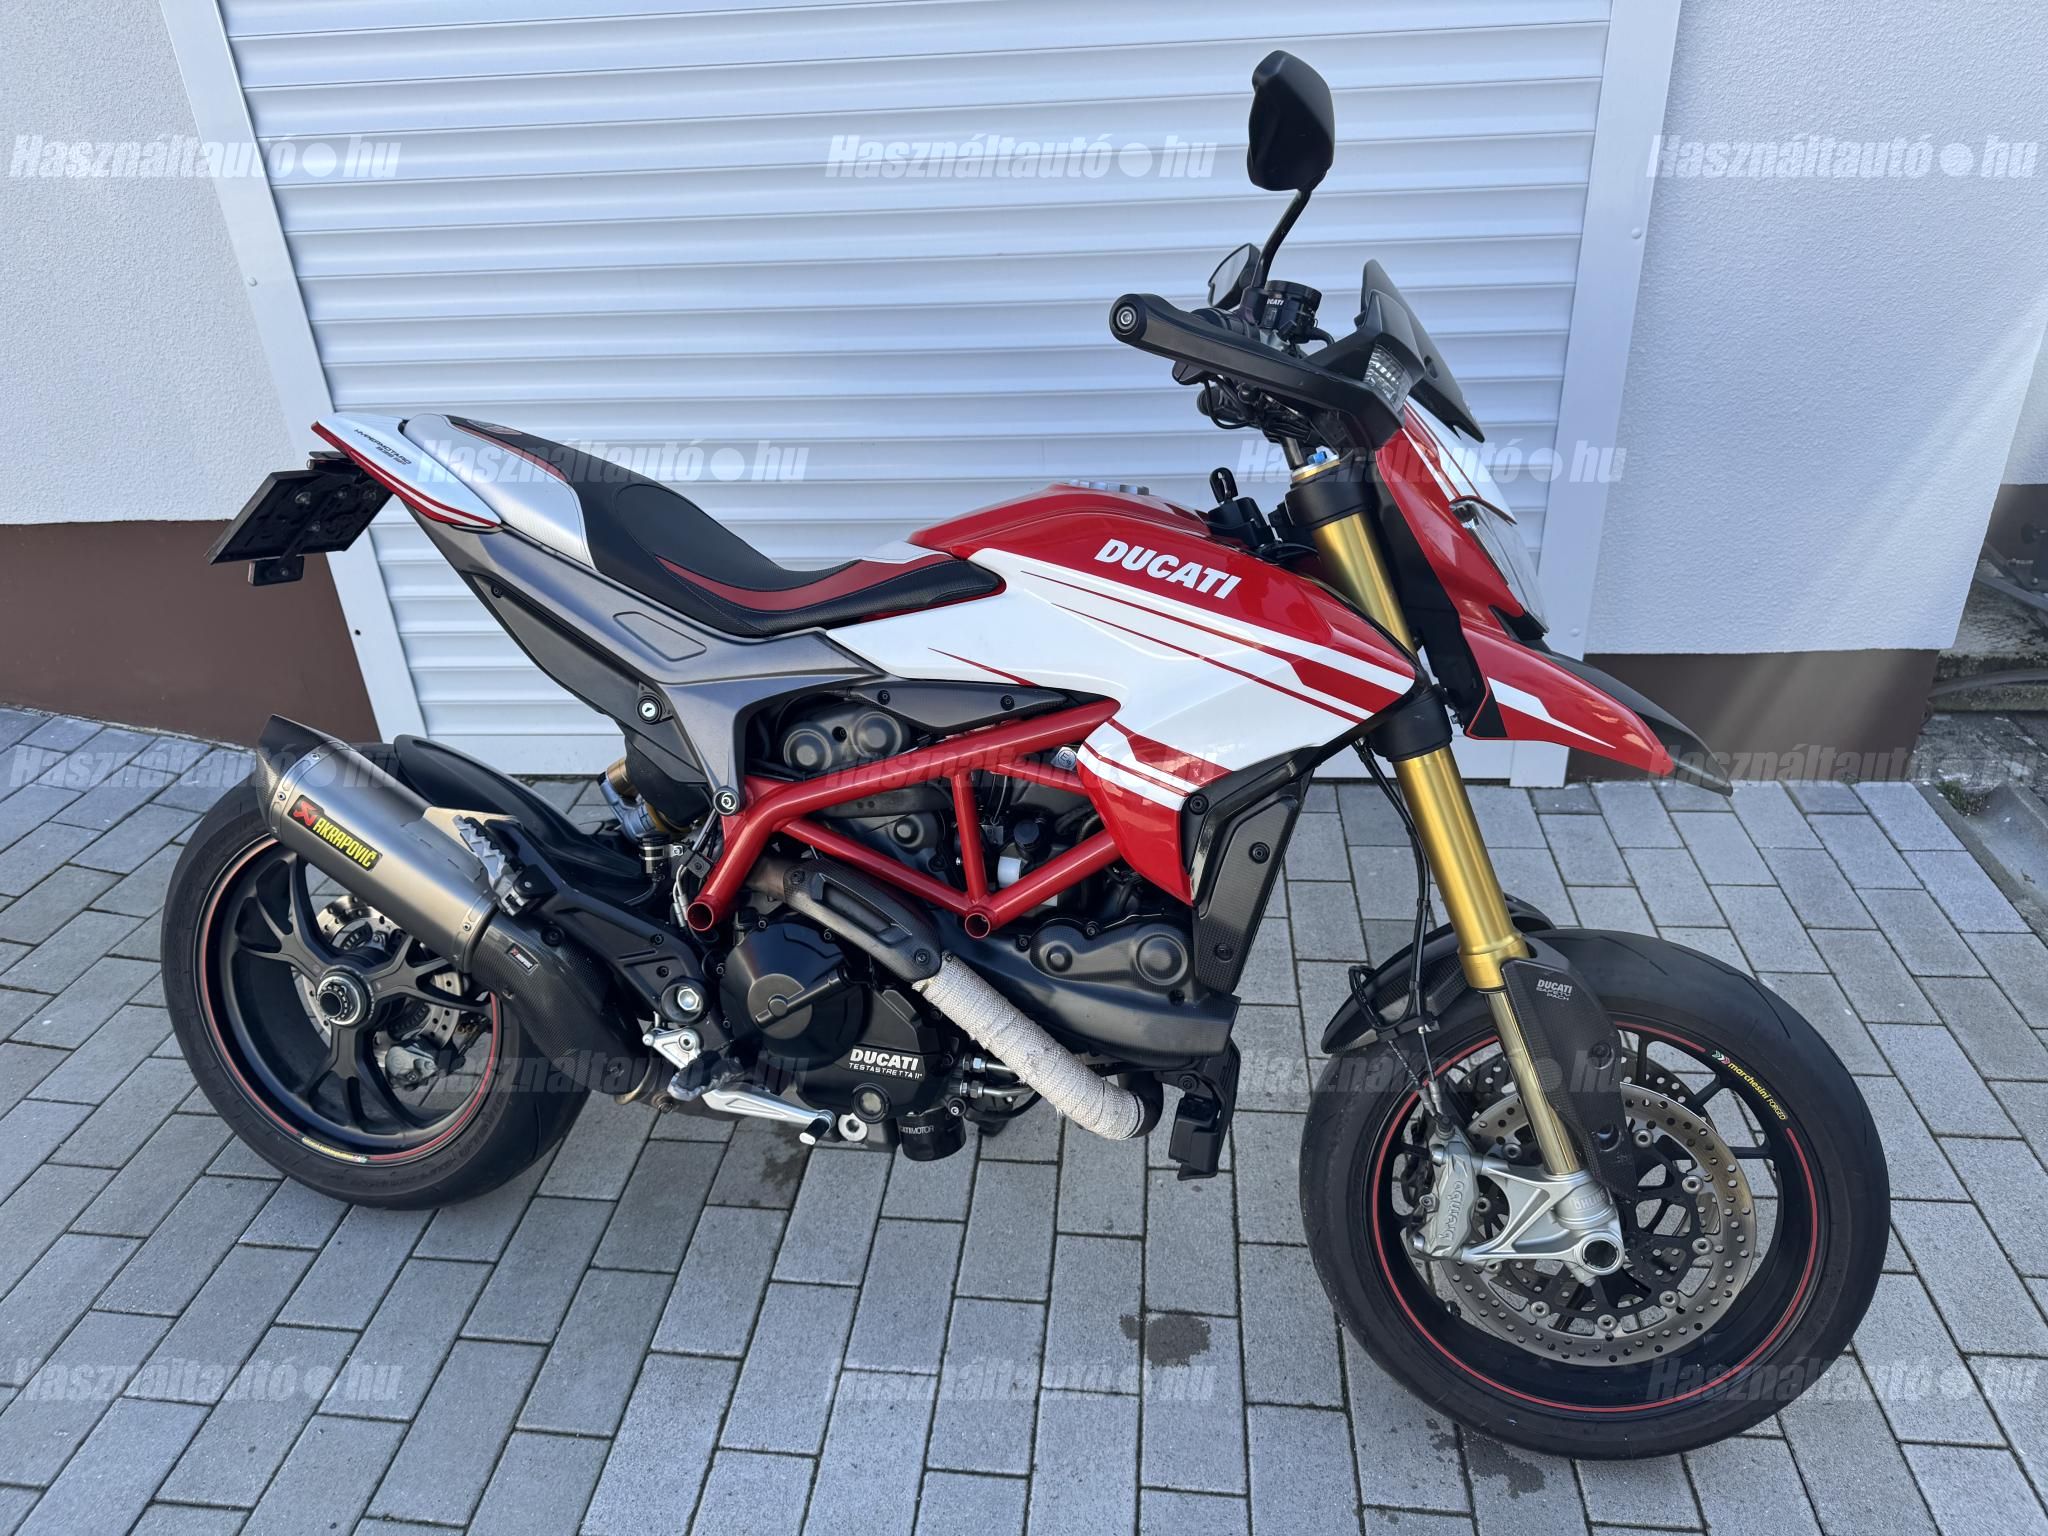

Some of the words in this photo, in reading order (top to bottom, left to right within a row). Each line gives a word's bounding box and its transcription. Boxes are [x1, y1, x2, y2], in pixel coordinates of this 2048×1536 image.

[1094, 538, 1243, 600] DUCATI
[1537, 979, 1572, 994] DUCATI
[848, 1062, 913, 1079] TESTASTRETTA
[849, 1049, 919, 1071] DUCATI
[1728, 1063, 1772, 1099] marchesini
[1767, 1098, 1787, 1120] FORGED
[1439, 1181, 1465, 1241] brembo
